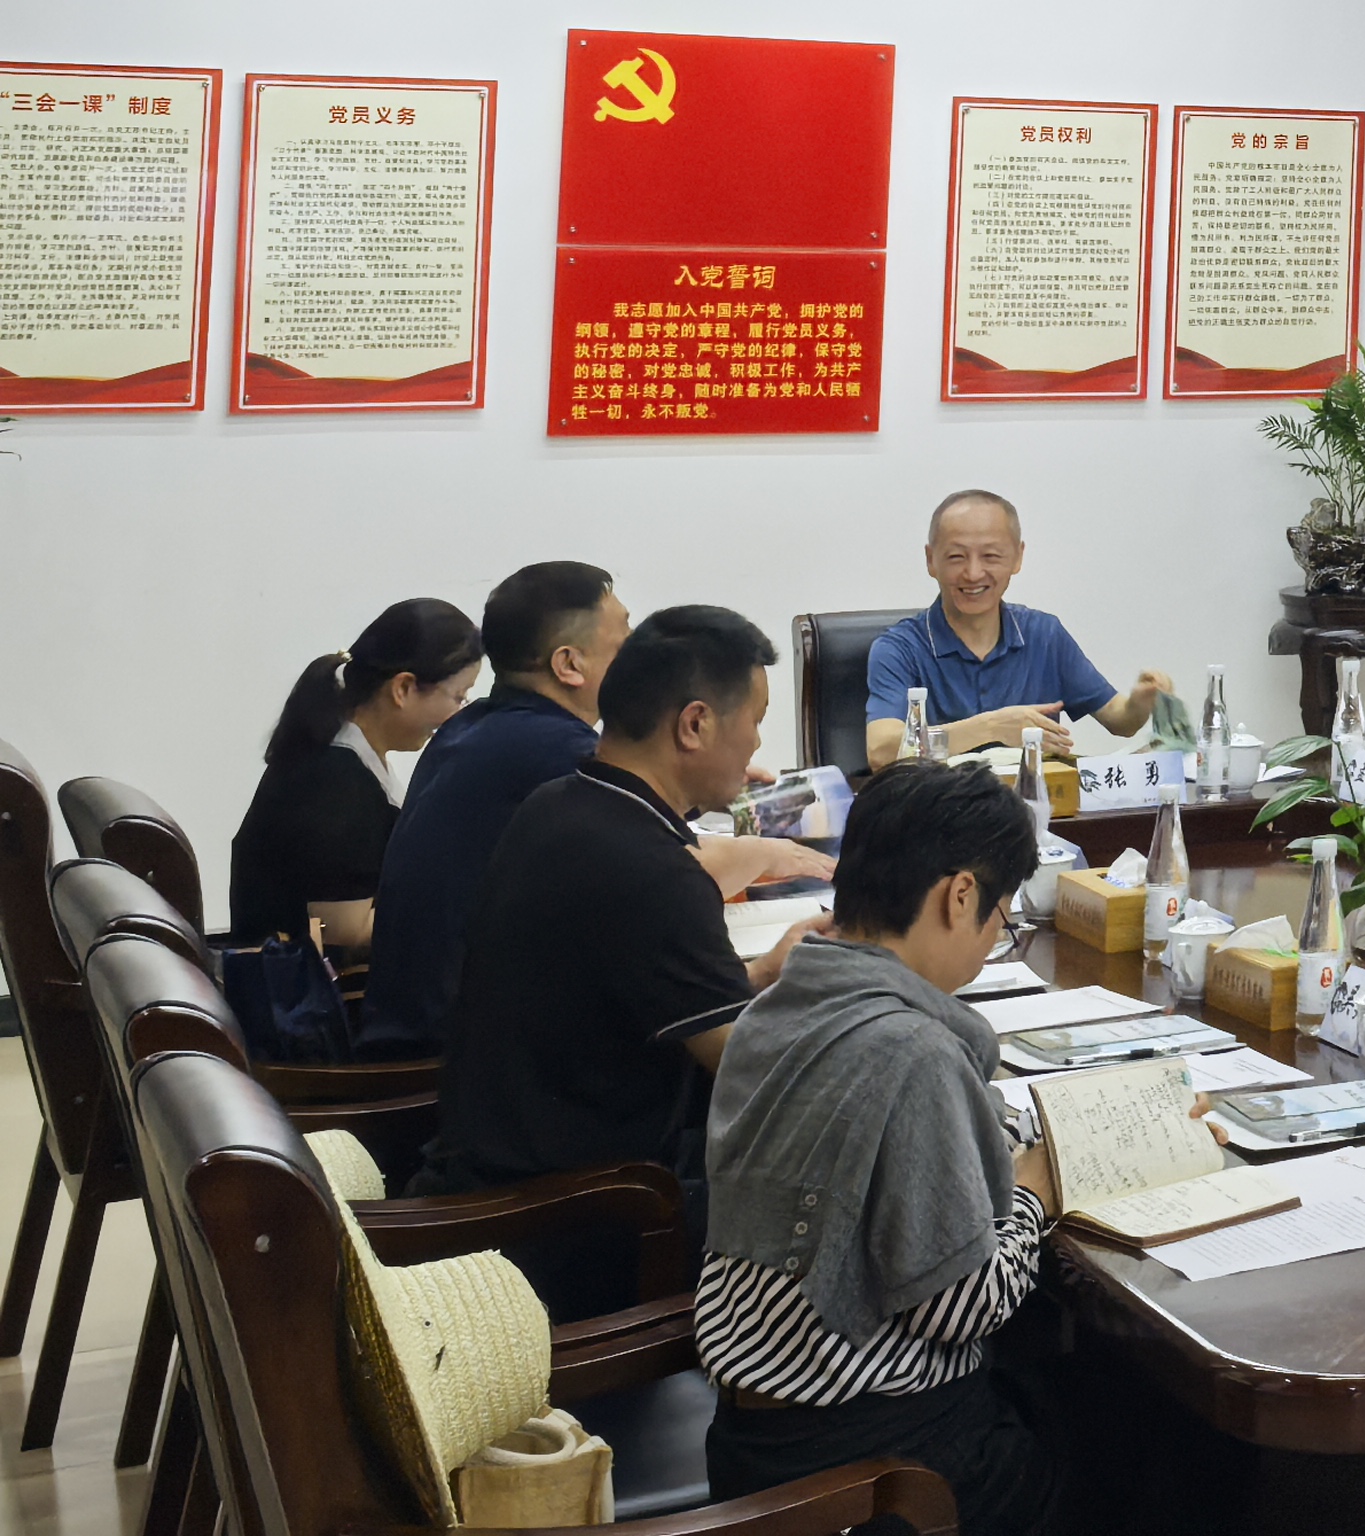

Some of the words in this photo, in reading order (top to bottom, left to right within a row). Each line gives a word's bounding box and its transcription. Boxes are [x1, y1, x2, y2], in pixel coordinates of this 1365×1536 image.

[328, 105, 417, 126] 党员义务
[1020, 125, 1092, 145] 党员权利
[1231, 132, 1310, 151] 党的宗旨
[674, 264, 776, 290] 入党誓词
